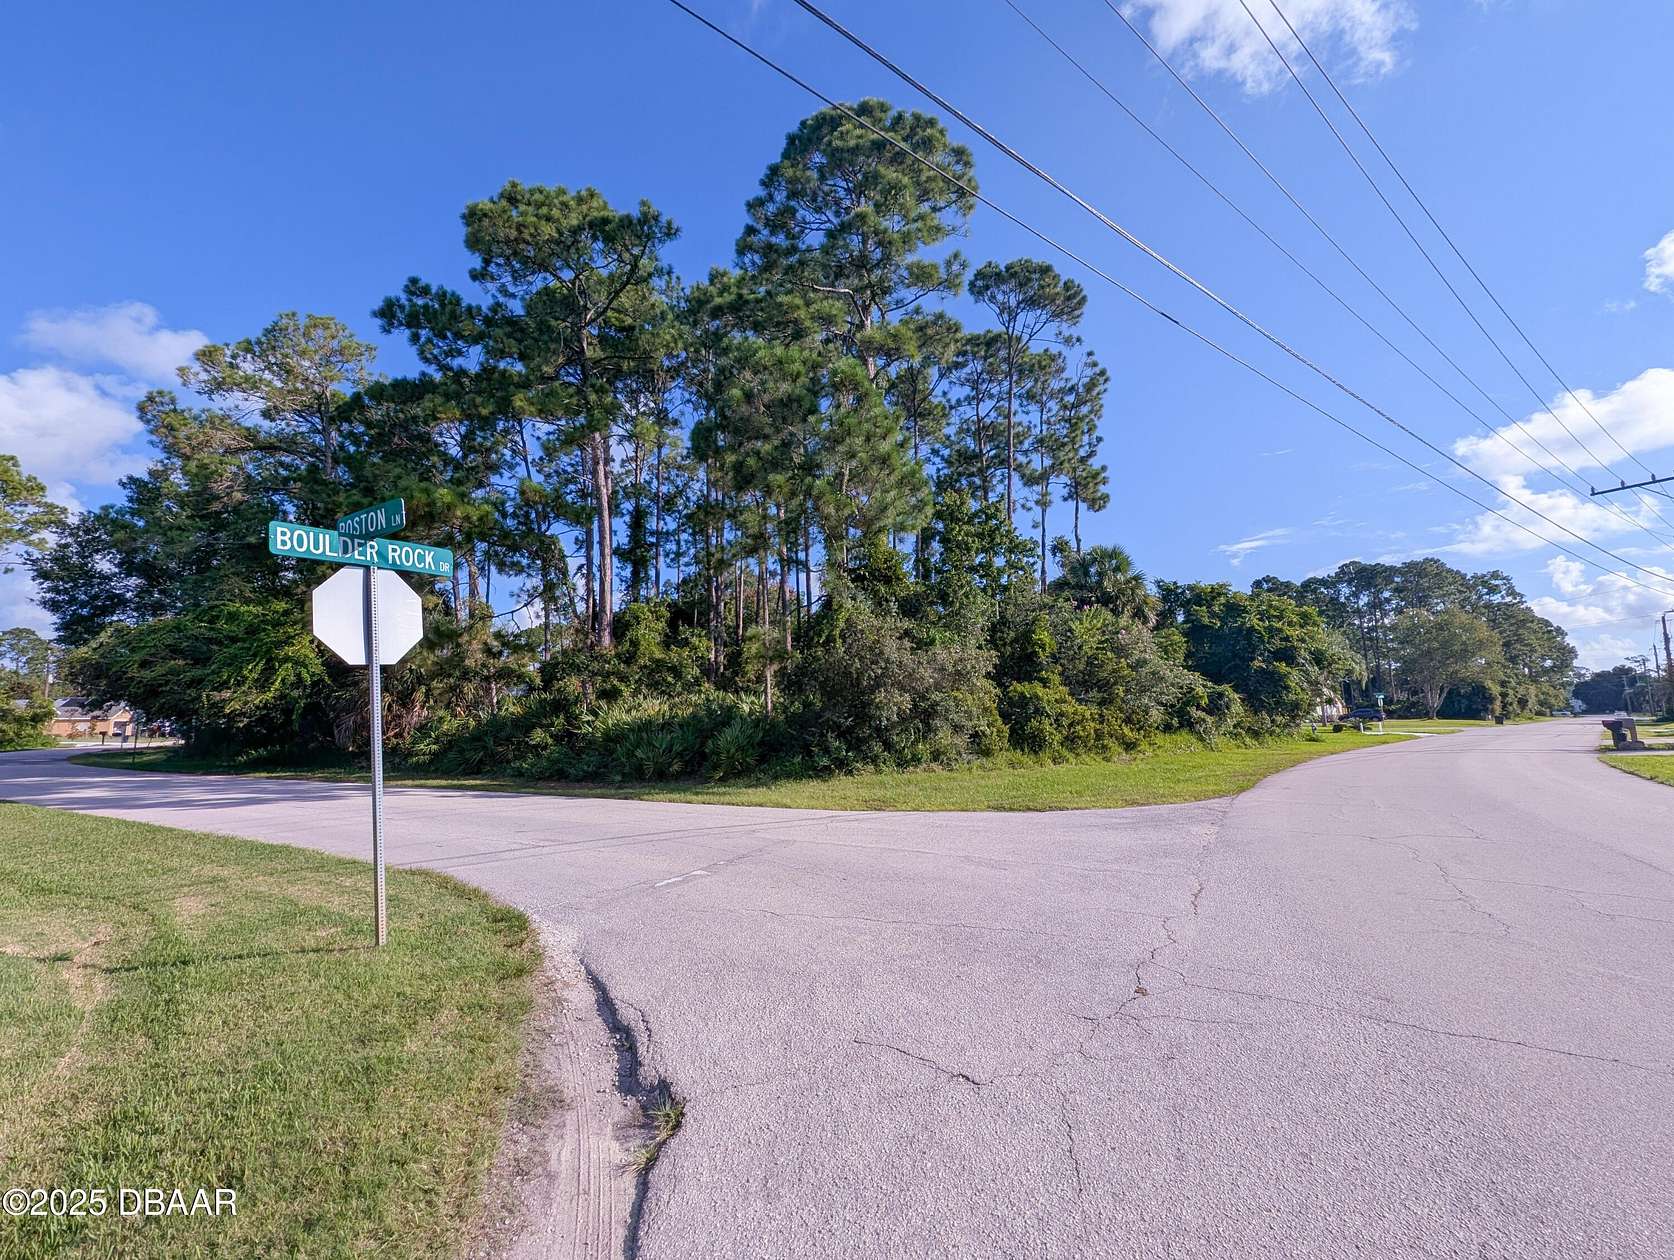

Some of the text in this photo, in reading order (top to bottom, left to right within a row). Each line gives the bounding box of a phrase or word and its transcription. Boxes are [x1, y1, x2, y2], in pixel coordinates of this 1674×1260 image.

[339, 508, 401, 534] BOSTON LN
[276, 526, 450, 573] BOULDER ROCK DR
